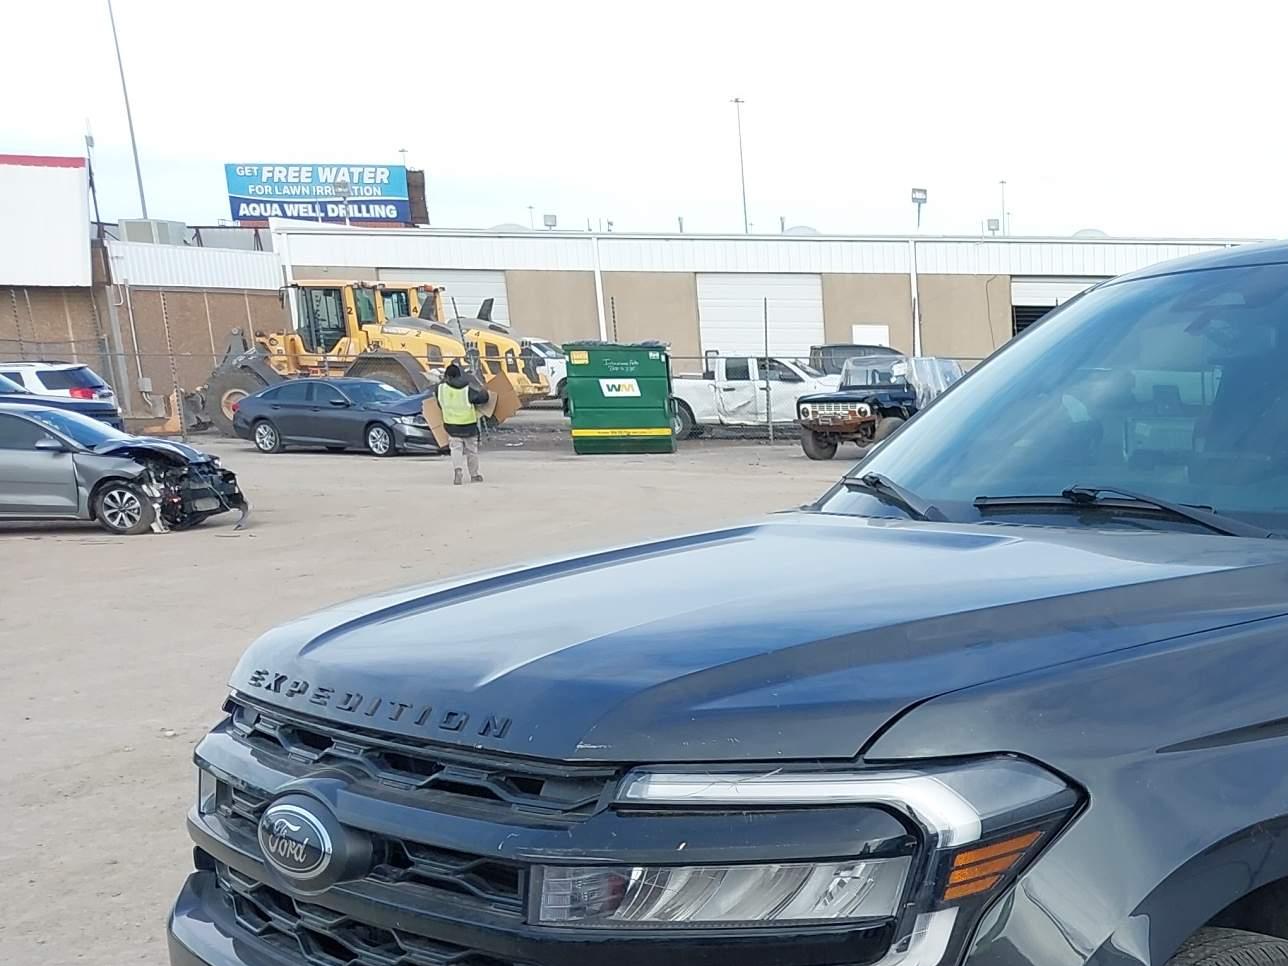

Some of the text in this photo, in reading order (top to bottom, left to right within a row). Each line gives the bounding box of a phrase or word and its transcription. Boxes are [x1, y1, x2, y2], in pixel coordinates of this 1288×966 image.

[236, 166, 390, 184] GET FREE WATER
[248, 184, 273, 195] FOR
[275, 184, 310, 196] LAWN
[239, 202, 398, 219] AQUA WELL DRILLING
[605, 383, 635, 392] WM
[248, 669, 513, 739] EXPEDITION
[270, 818, 309, 864] Ford
